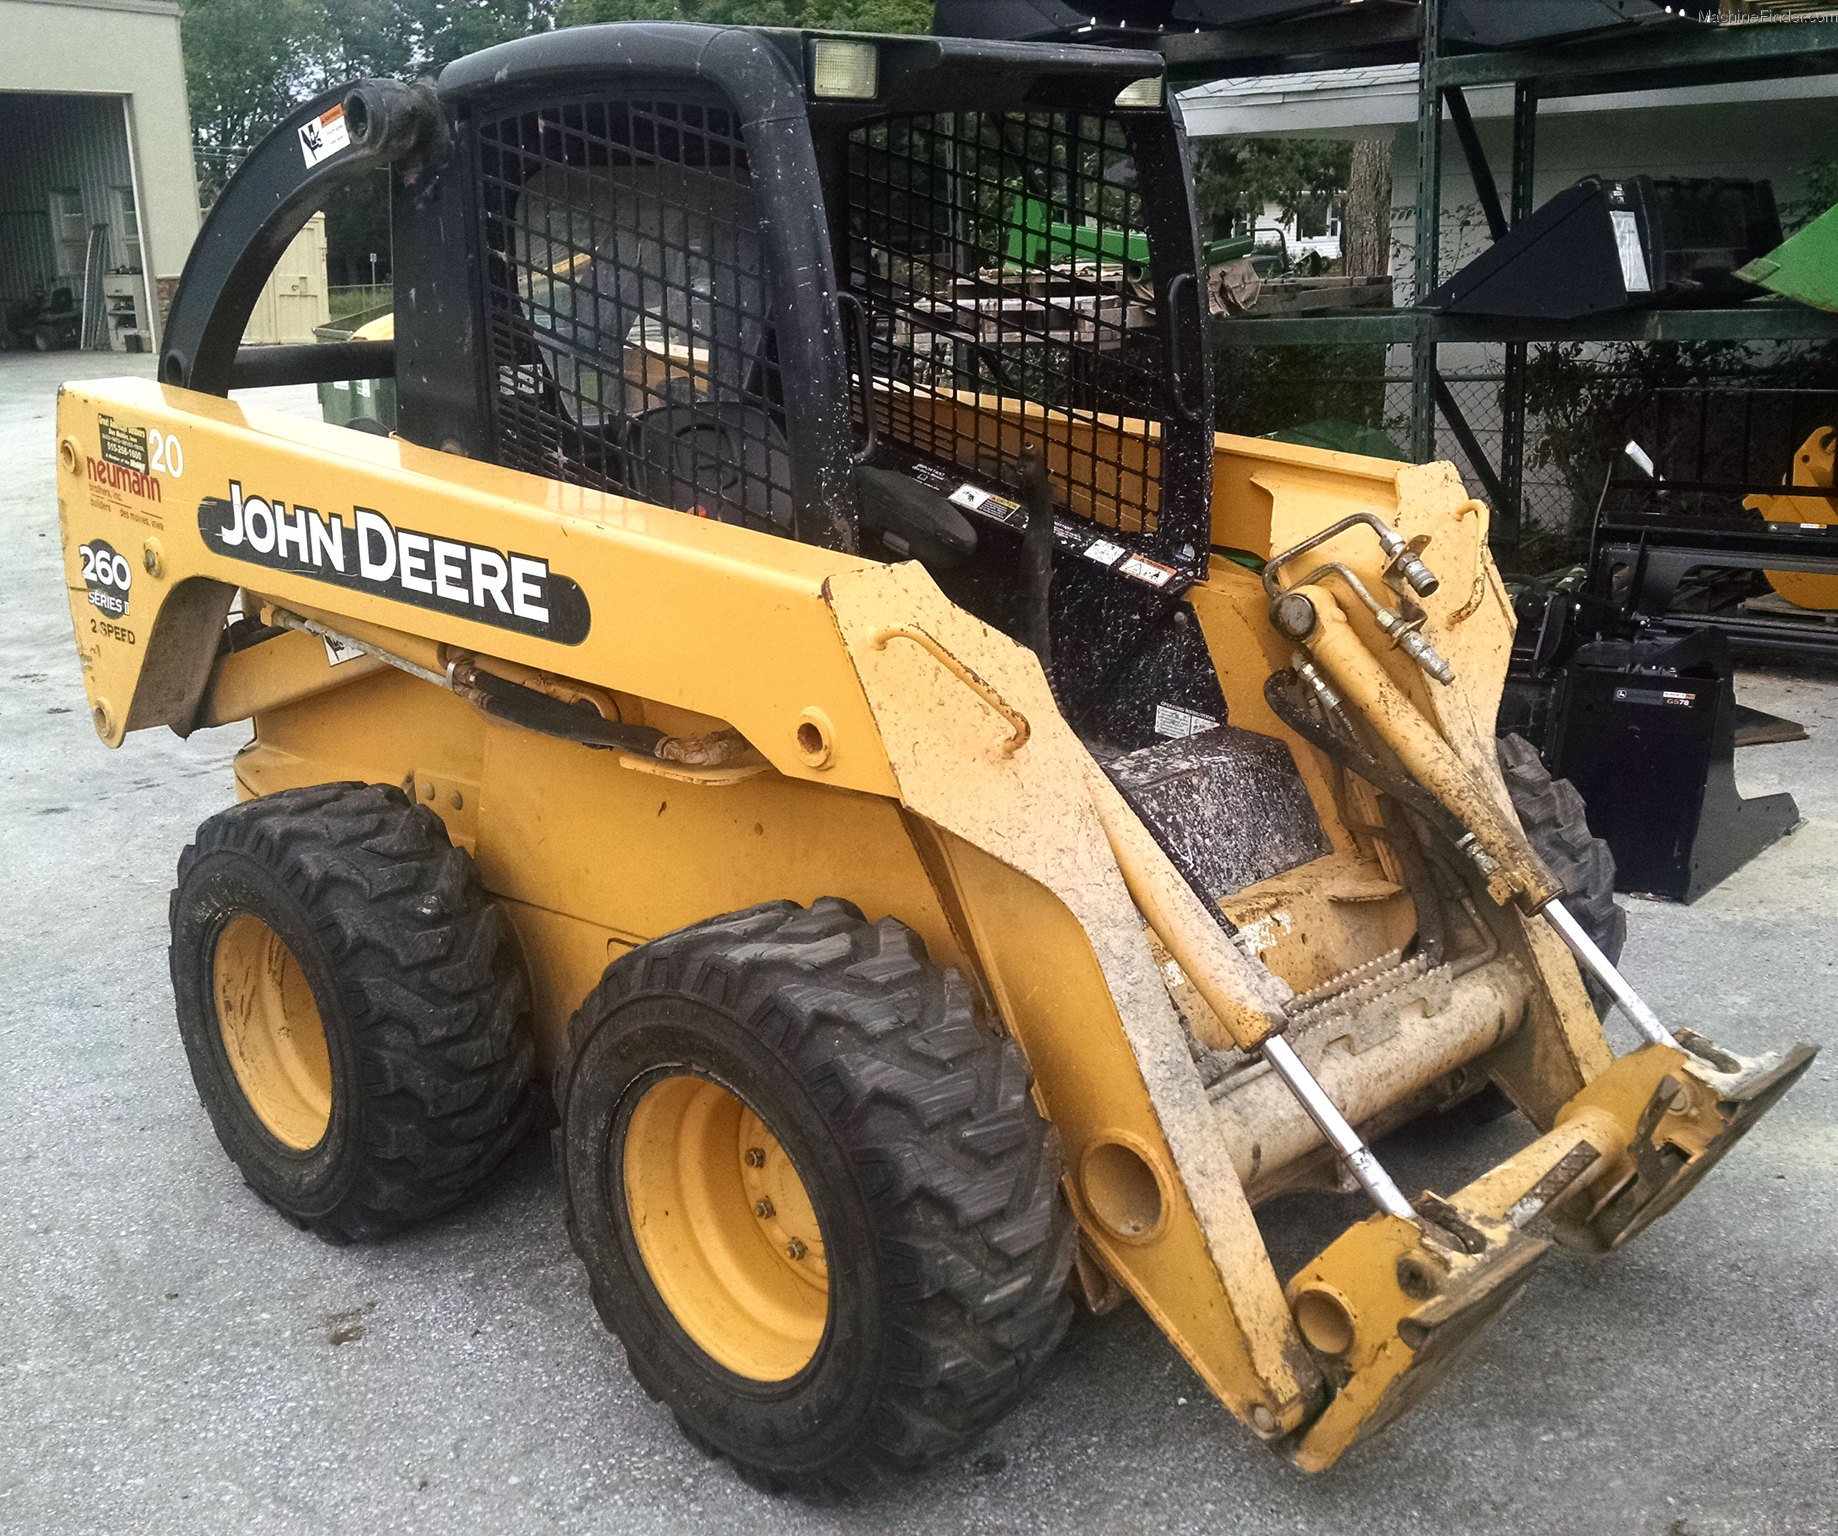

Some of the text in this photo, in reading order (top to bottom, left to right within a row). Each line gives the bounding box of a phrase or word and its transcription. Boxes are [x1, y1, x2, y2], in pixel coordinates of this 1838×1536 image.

[149, 428, 184, 478] 20
[86, 456, 162, 503] neumann
[79, 545, 131, 591] 260
[221, 482, 550, 624] JOHN DEERE
[88, 592, 123, 613] SERIES
[90, 619, 98, 634] 2
